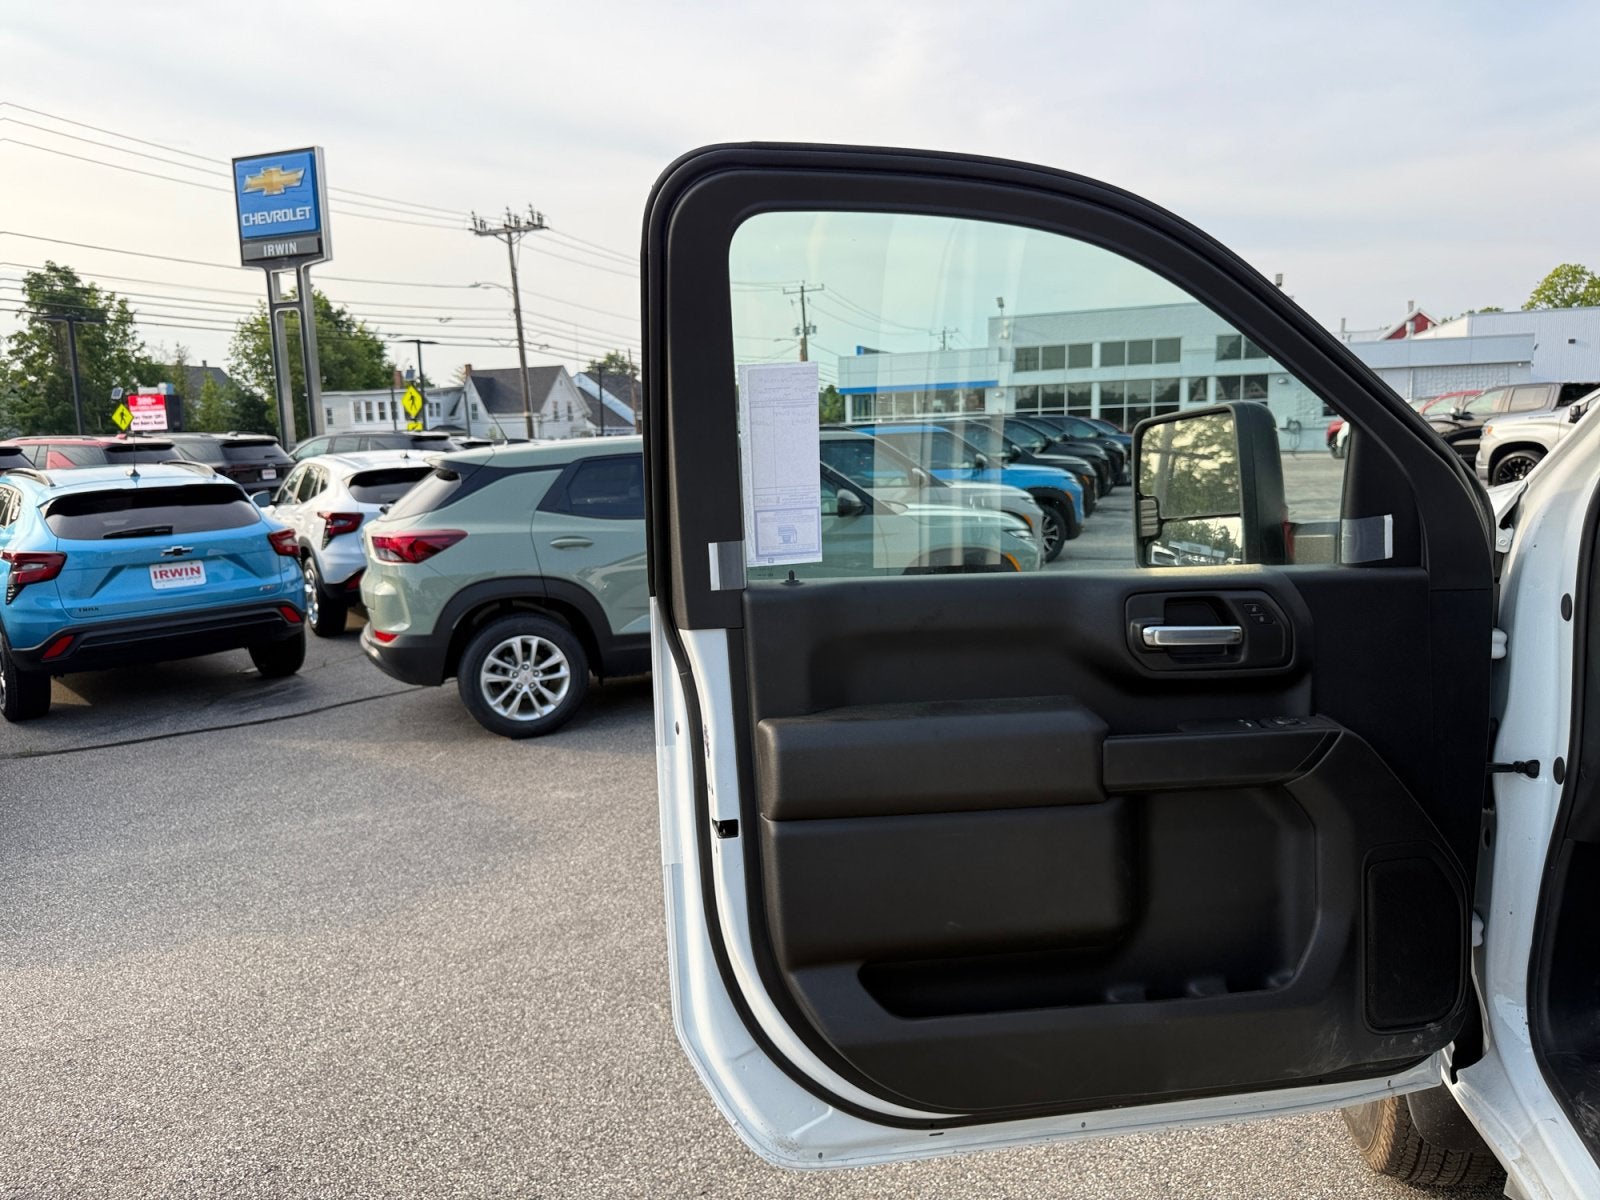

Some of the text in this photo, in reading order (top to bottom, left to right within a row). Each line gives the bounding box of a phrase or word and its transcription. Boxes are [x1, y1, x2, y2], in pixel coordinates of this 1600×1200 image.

[242, 206, 311, 226] CHEVROLET
[263, 242, 297, 257] IRWIN
[153, 566, 201, 580] IRWIN
